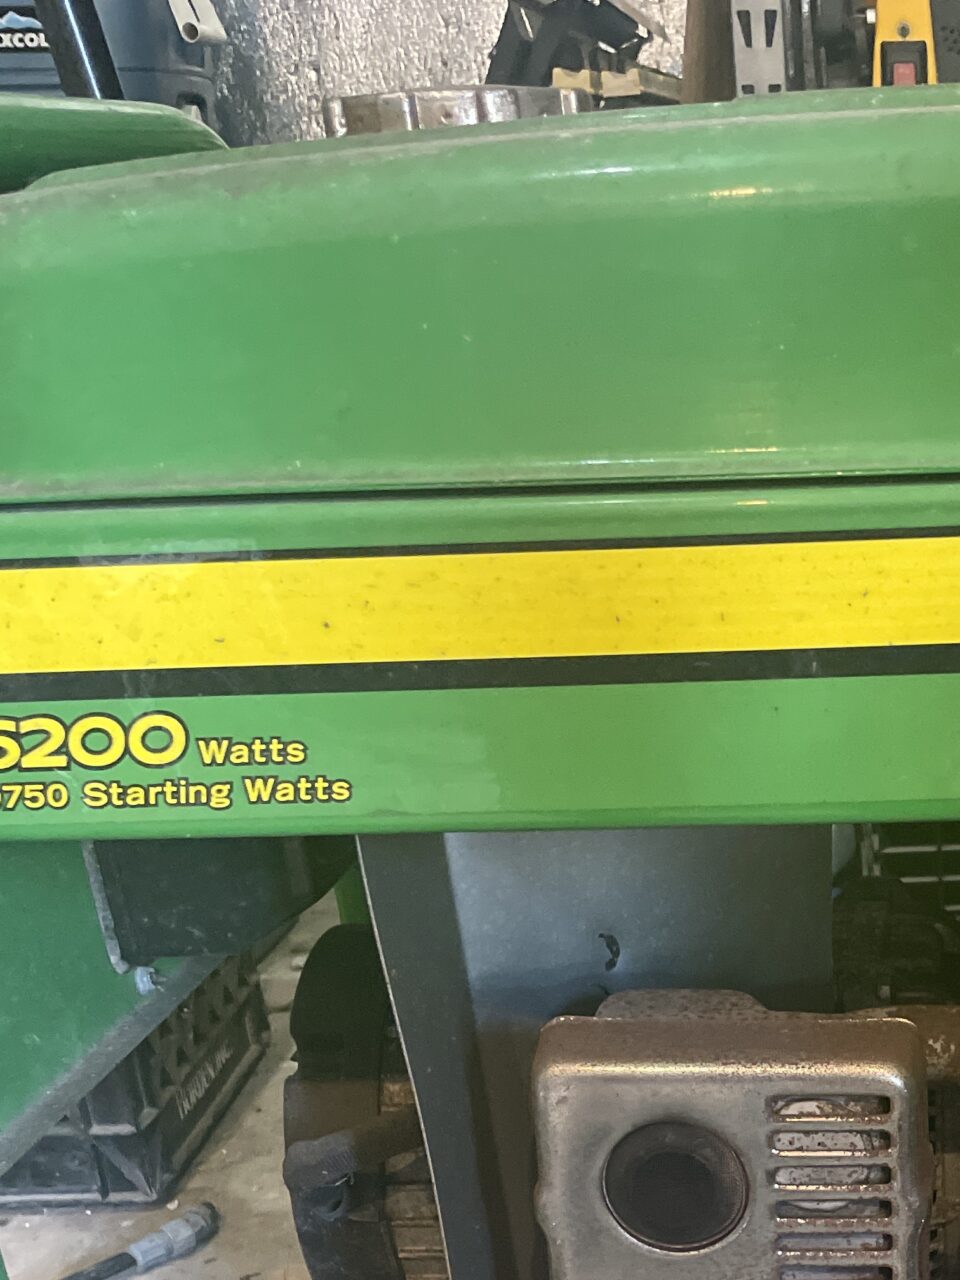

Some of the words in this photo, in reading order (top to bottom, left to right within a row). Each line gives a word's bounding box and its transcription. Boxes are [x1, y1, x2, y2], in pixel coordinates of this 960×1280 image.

[196, 736, 308, 766] Watts
[81, 778, 231, 811] Starting
[243, 776, 353, 805] Watts
